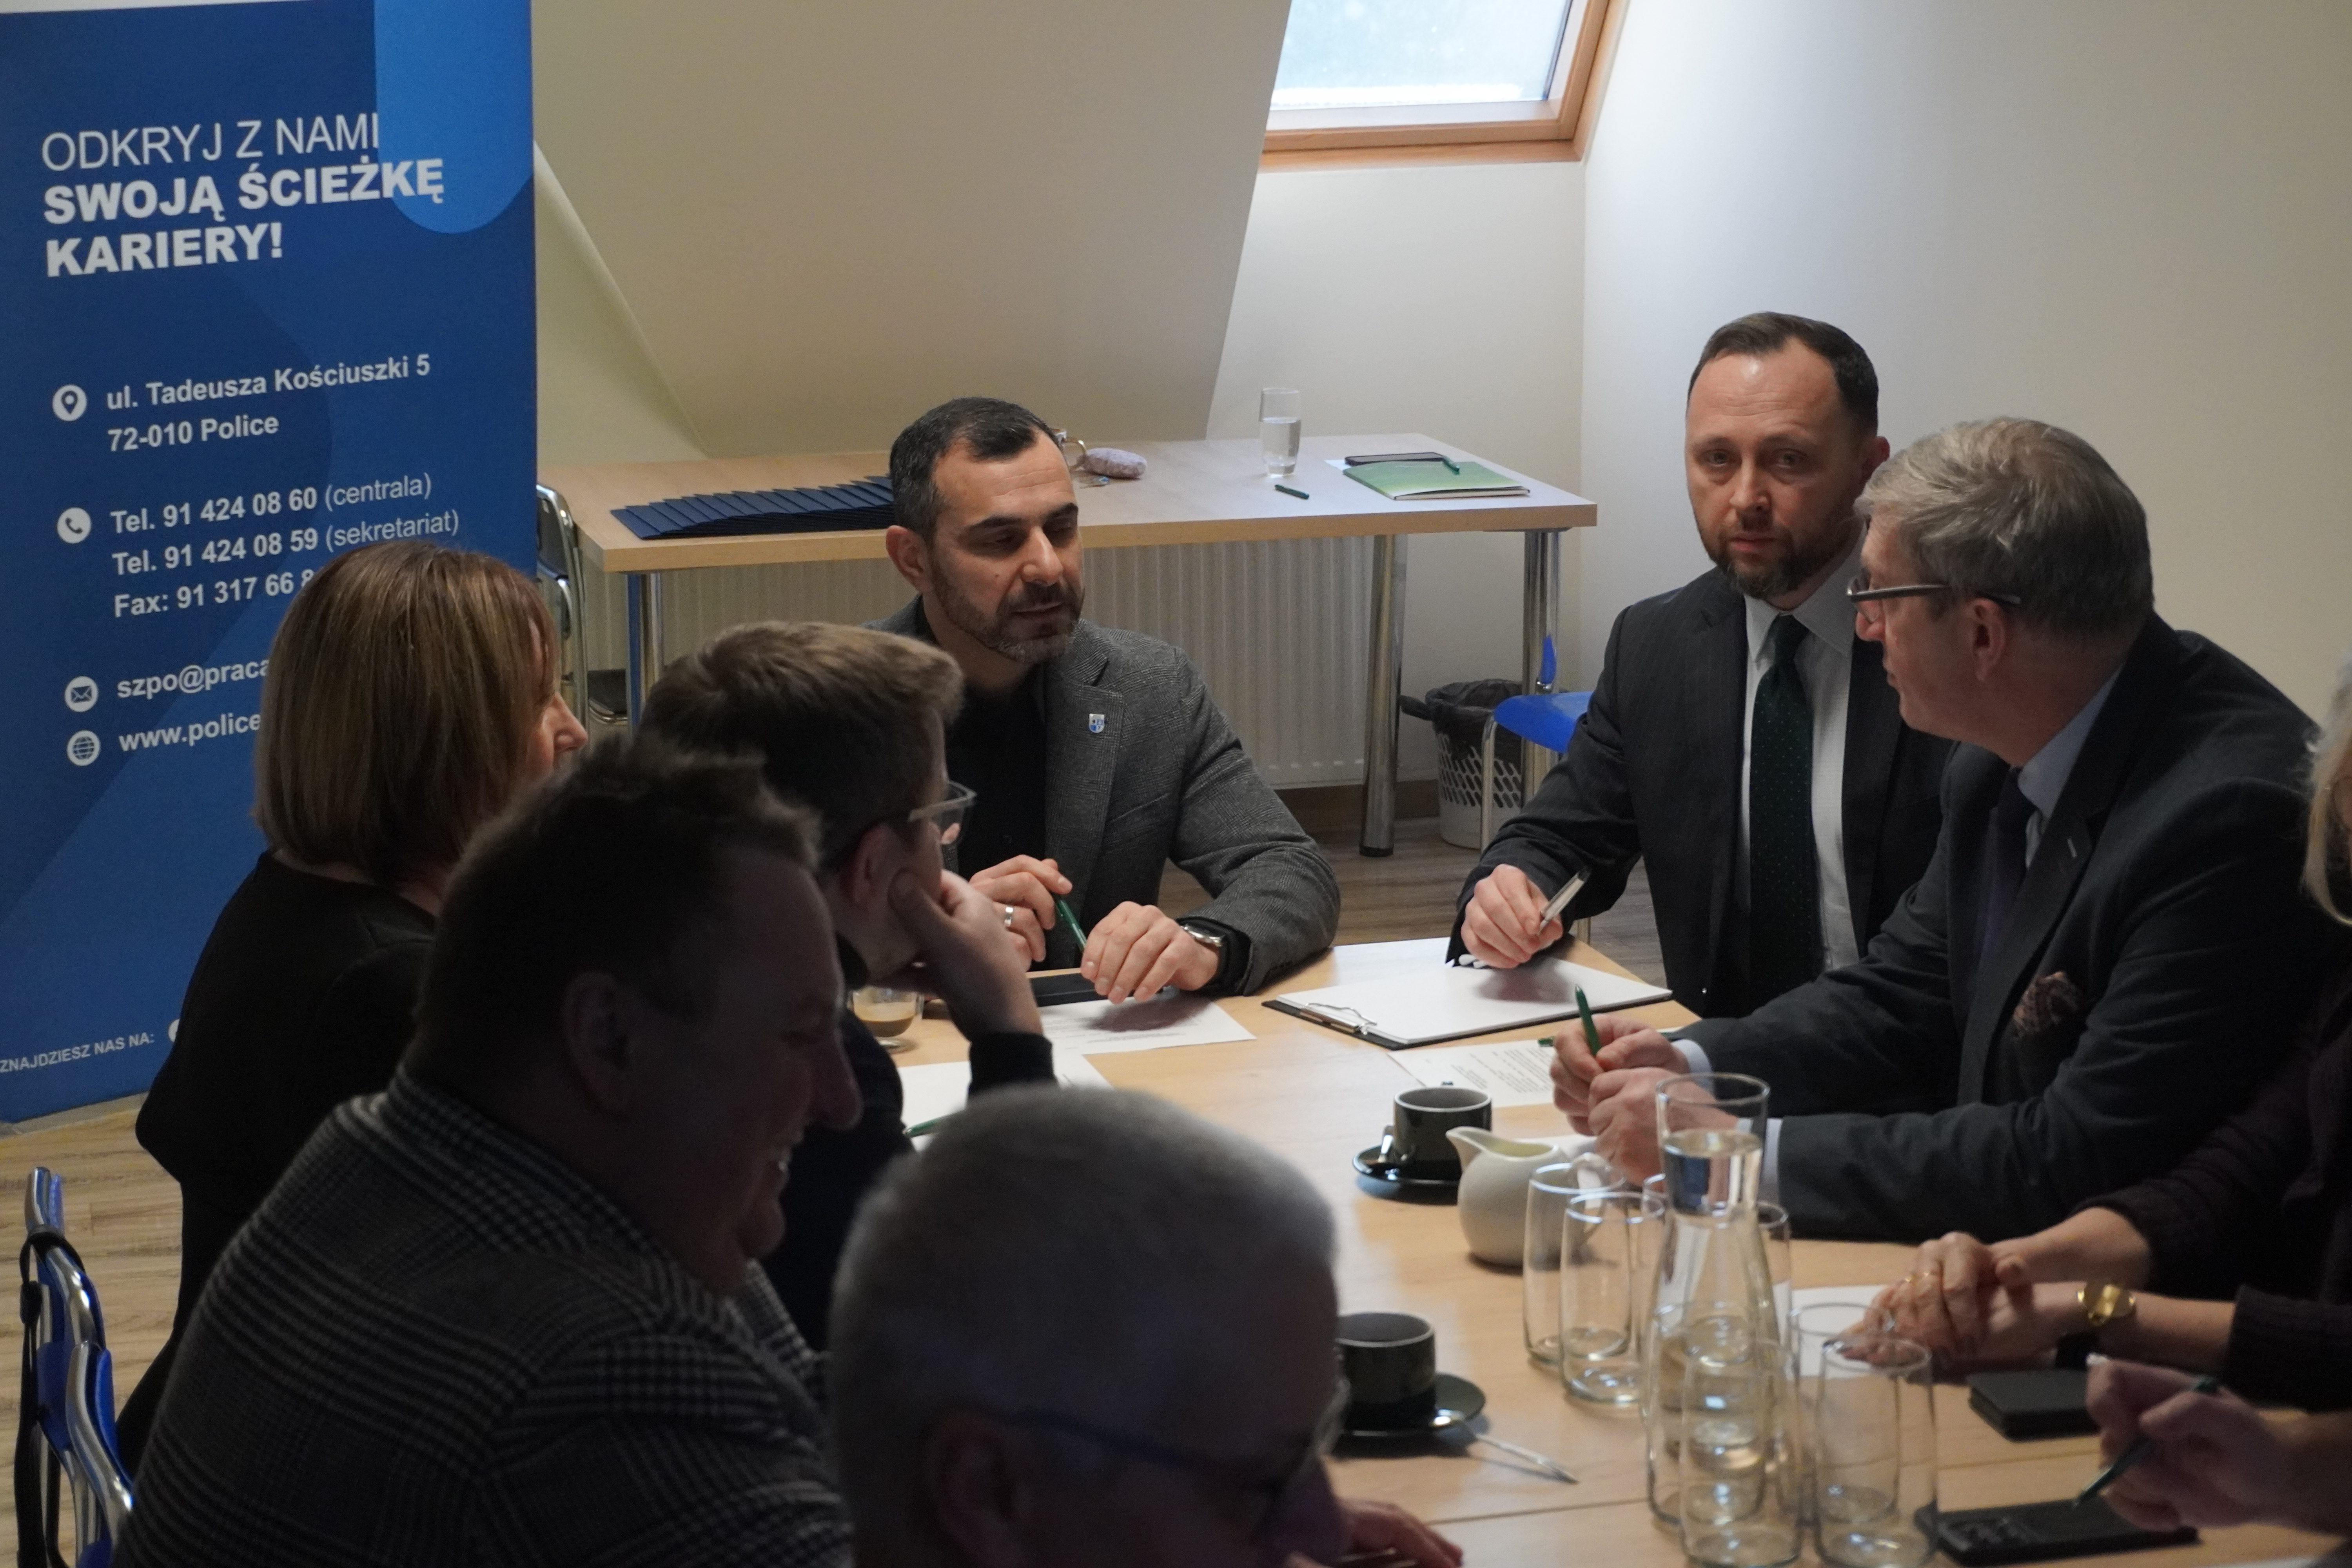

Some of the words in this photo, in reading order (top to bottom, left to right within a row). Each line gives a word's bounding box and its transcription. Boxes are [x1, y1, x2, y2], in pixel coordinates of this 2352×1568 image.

[42, 123, 221, 171] ODKRYJ
[236, 120, 263, 158] Z
[276, 113, 379, 154] NAMI
[44, 176, 225, 224] SWOJĄ
[238, 155, 444, 209] ŚCIEŻKĘ
[46, 221, 282, 277] KARIERY!
[107, 385, 138, 409] ul.
[146, 374, 267, 405] Tadeusza
[275, 356, 408, 391] Kościuszki
[417, 354, 430, 375] 5
[108, 421, 192, 451] 72-010
[201, 415, 278, 441] Police
[110, 508, 154, 533] Tel.
[163, 503, 190, 527] 91
[201, 496, 245, 521] 424
[253, 492, 281, 515] 08
[289, 487, 317, 511] 60
[325, 473, 431, 511] (centrala)
[112, 550, 156, 575] Tel.
[165, 544, 191, 568] 91
[202, 537, 246, 563] 424
[254, 533, 282, 557] 08
[291, 528, 318, 552] 59
[326, 510, 459, 552] (sekretariat)
[114, 592, 168, 617] Fax:
[177, 584, 203, 608] 91
[215, 577, 257, 603] 317
[265, 572, 294, 596] 66
[119, 713, 261, 751] www.police
[0, 1044, 91, 1073] ZNAJDZIESZ
[94, 1037, 125, 1054] NAS
